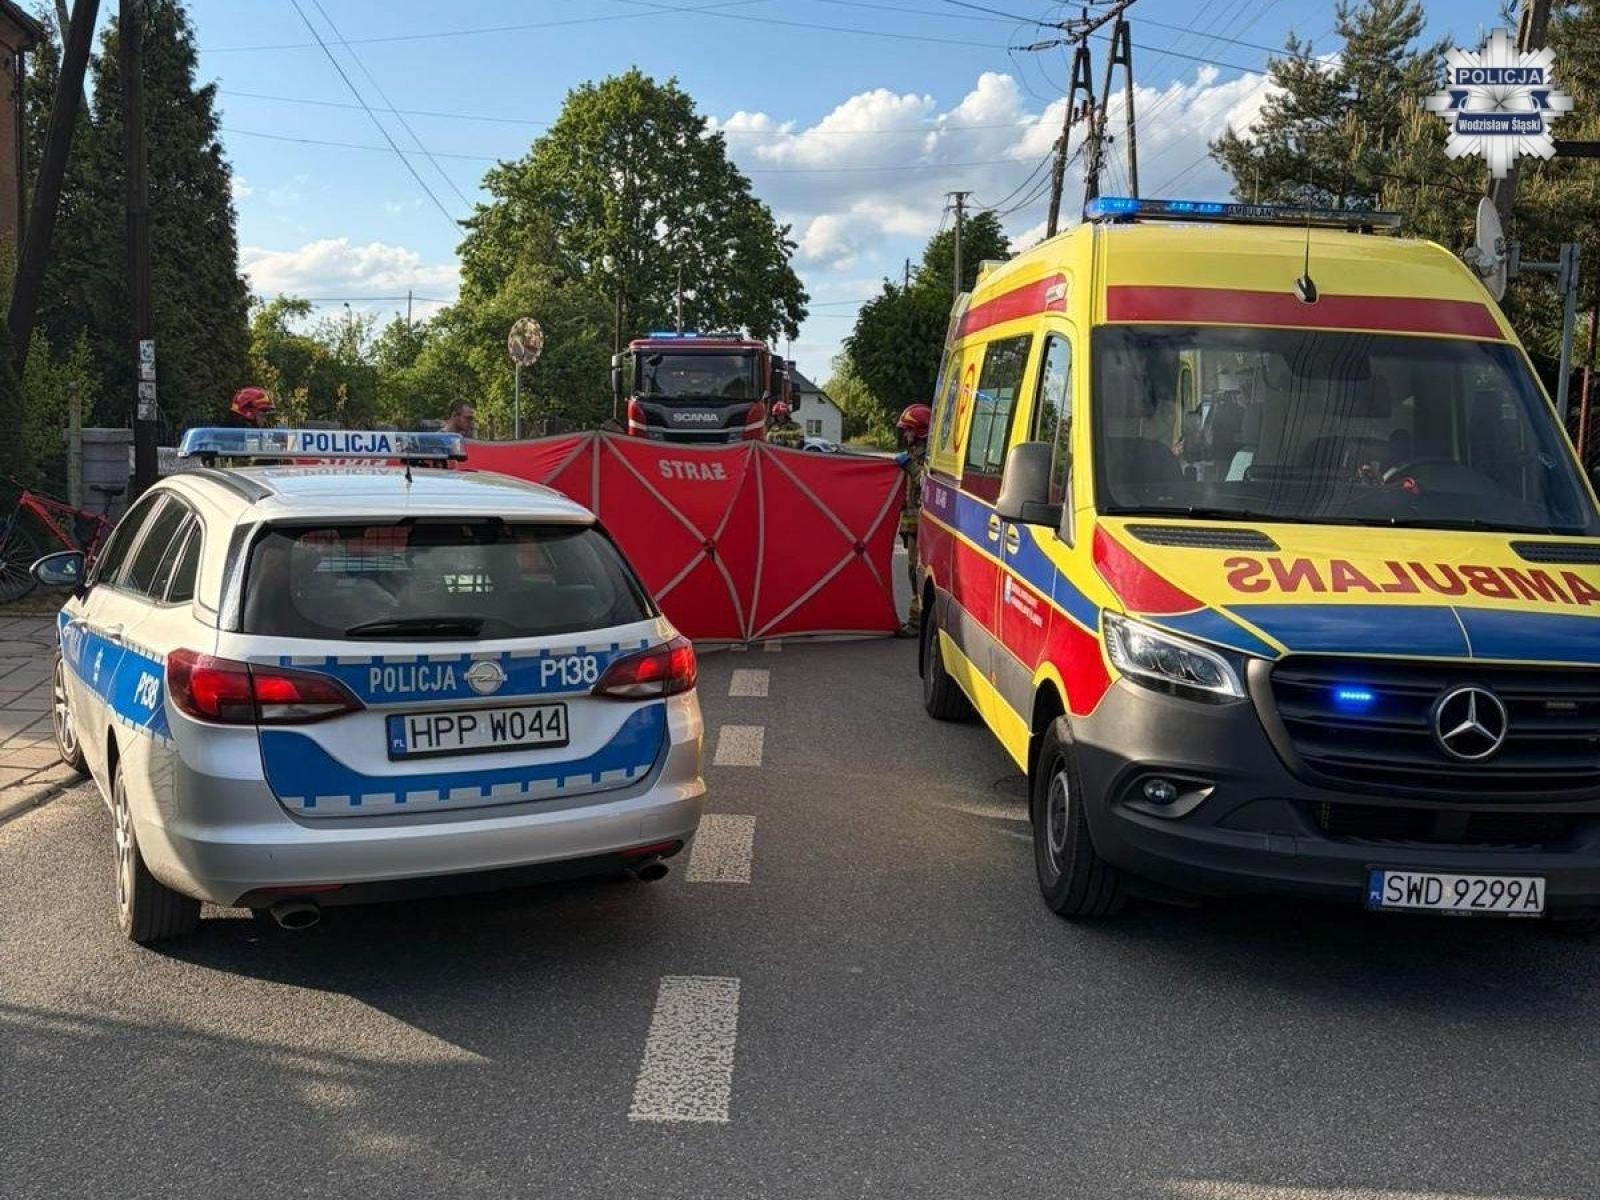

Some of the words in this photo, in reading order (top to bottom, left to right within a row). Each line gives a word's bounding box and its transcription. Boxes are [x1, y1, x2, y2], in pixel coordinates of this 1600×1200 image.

[672, 412, 719, 422] SCANIA
[302, 432, 391, 453] POLICJA
[369, 665, 457, 693] POLICJA
[540, 655, 599, 688] P138
[410, 713, 478, 749] HPP
[490, 708, 562, 742] W044
[1386, 875, 1443, 905] SWD
[1453, 878, 1540, 910] 9299A
